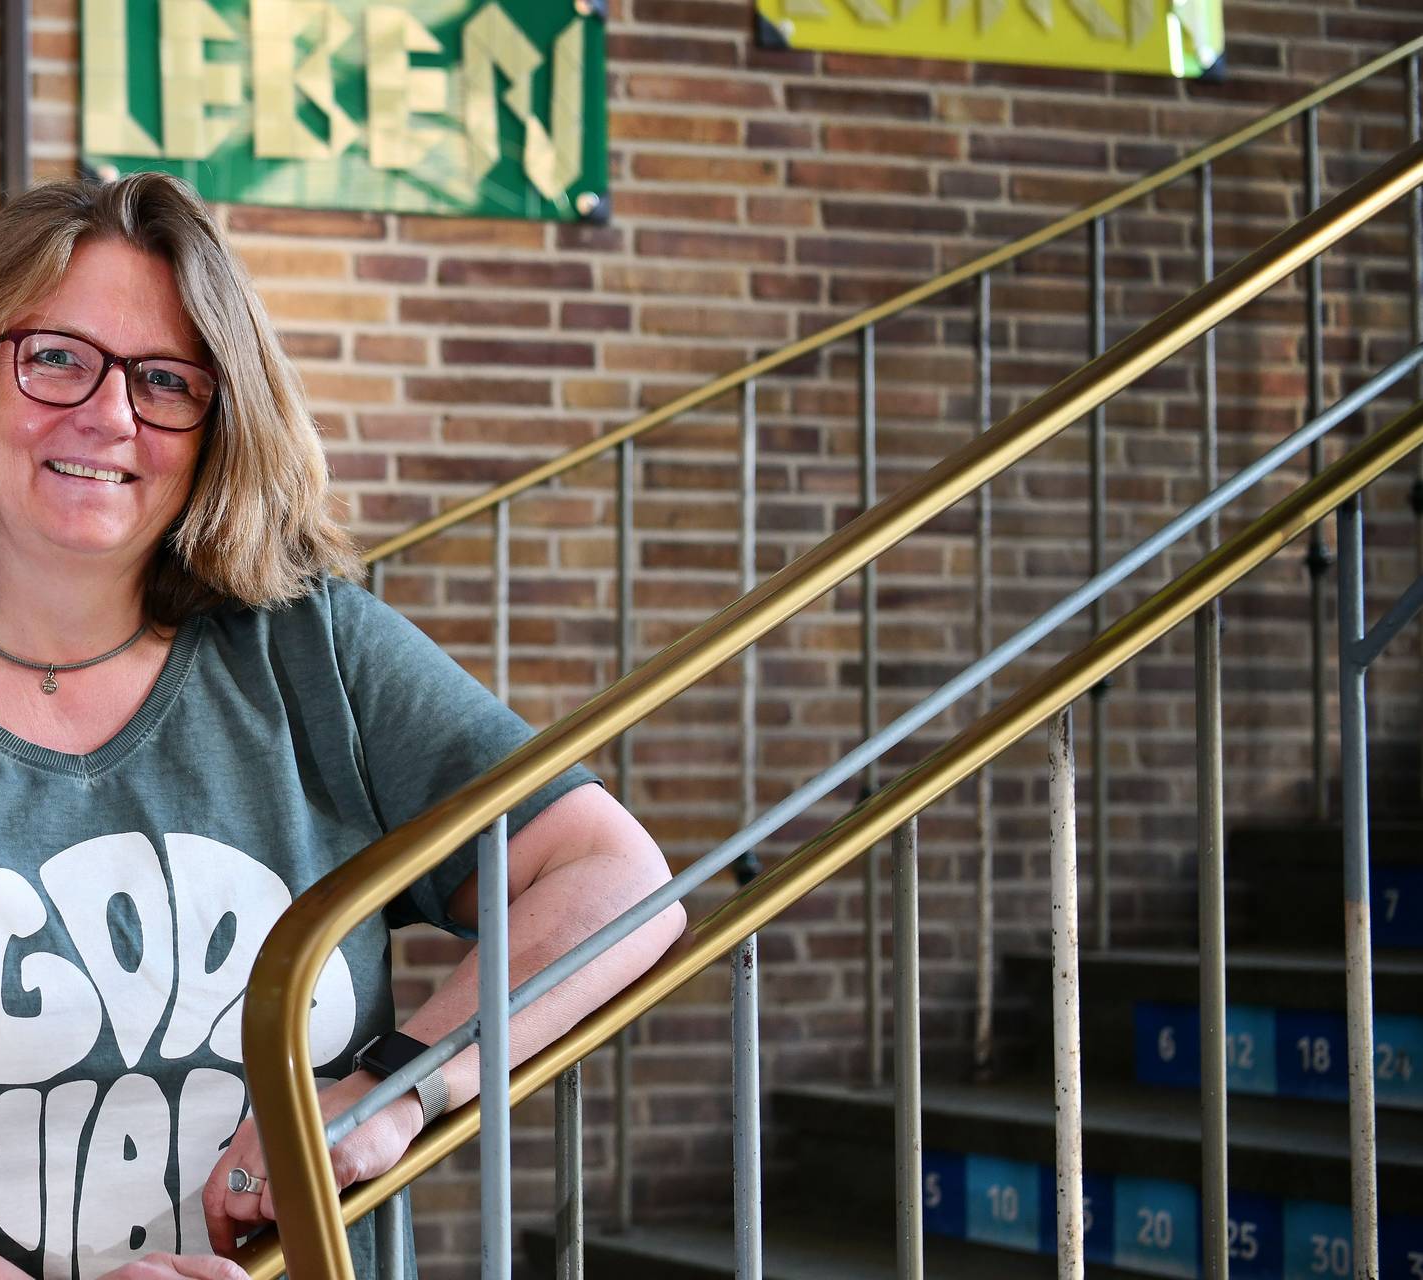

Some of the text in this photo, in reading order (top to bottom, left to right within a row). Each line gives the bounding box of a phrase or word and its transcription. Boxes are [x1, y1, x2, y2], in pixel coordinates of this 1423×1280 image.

[83, 0, 585, 200] LEBEN
[1157, 1026, 1177, 1062] 6
[1296, 1035, 1331, 1074] 18
[986, 1184, 1019, 1222] 10
[1136, 1208, 1174, 1249] 20
[1310, 1234, 1351, 1277] 30
